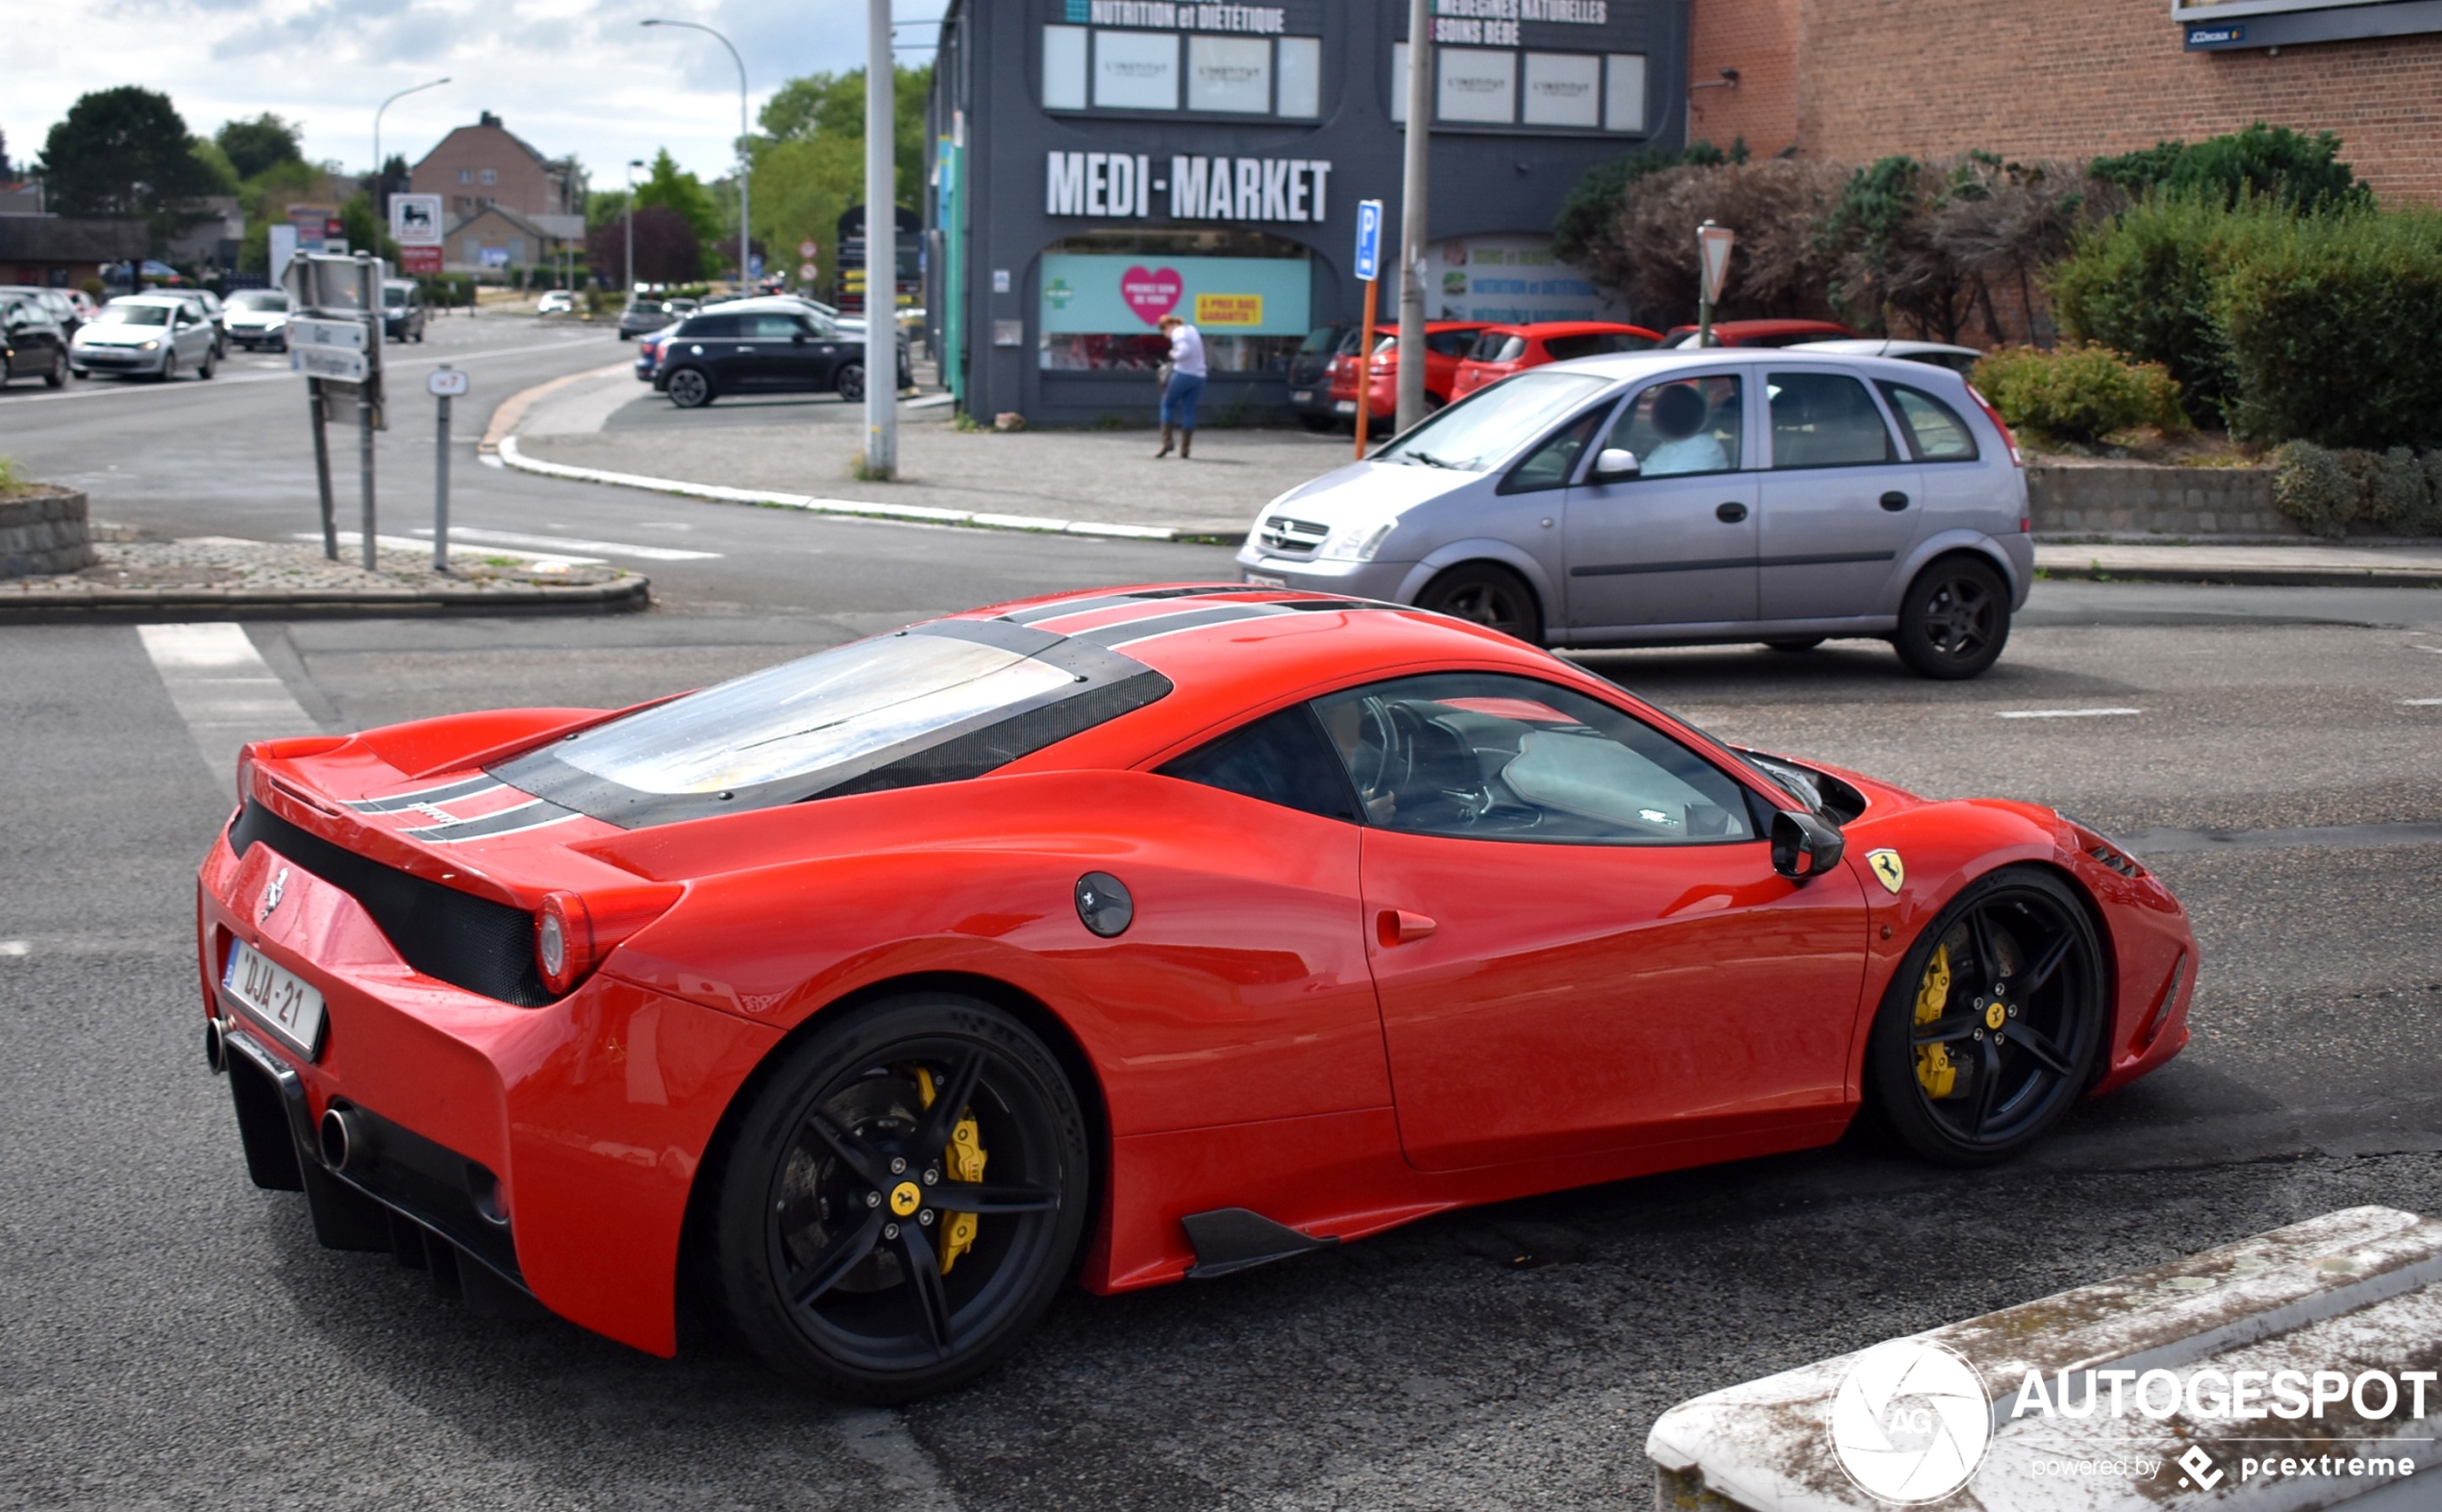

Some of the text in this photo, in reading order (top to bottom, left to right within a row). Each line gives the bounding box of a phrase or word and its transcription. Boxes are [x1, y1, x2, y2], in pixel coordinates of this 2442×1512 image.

[1091, 0, 1285, 33] NUTRITION et DIÉTÉTIQUE
[1521, 0, 1607, 24] NATURELLES
[1435, 17, 1521, 45] SOINS BÉBÉ
[2189, 30, 2230, 43] JCDecaux
[1361, 208, 1375, 247] P
